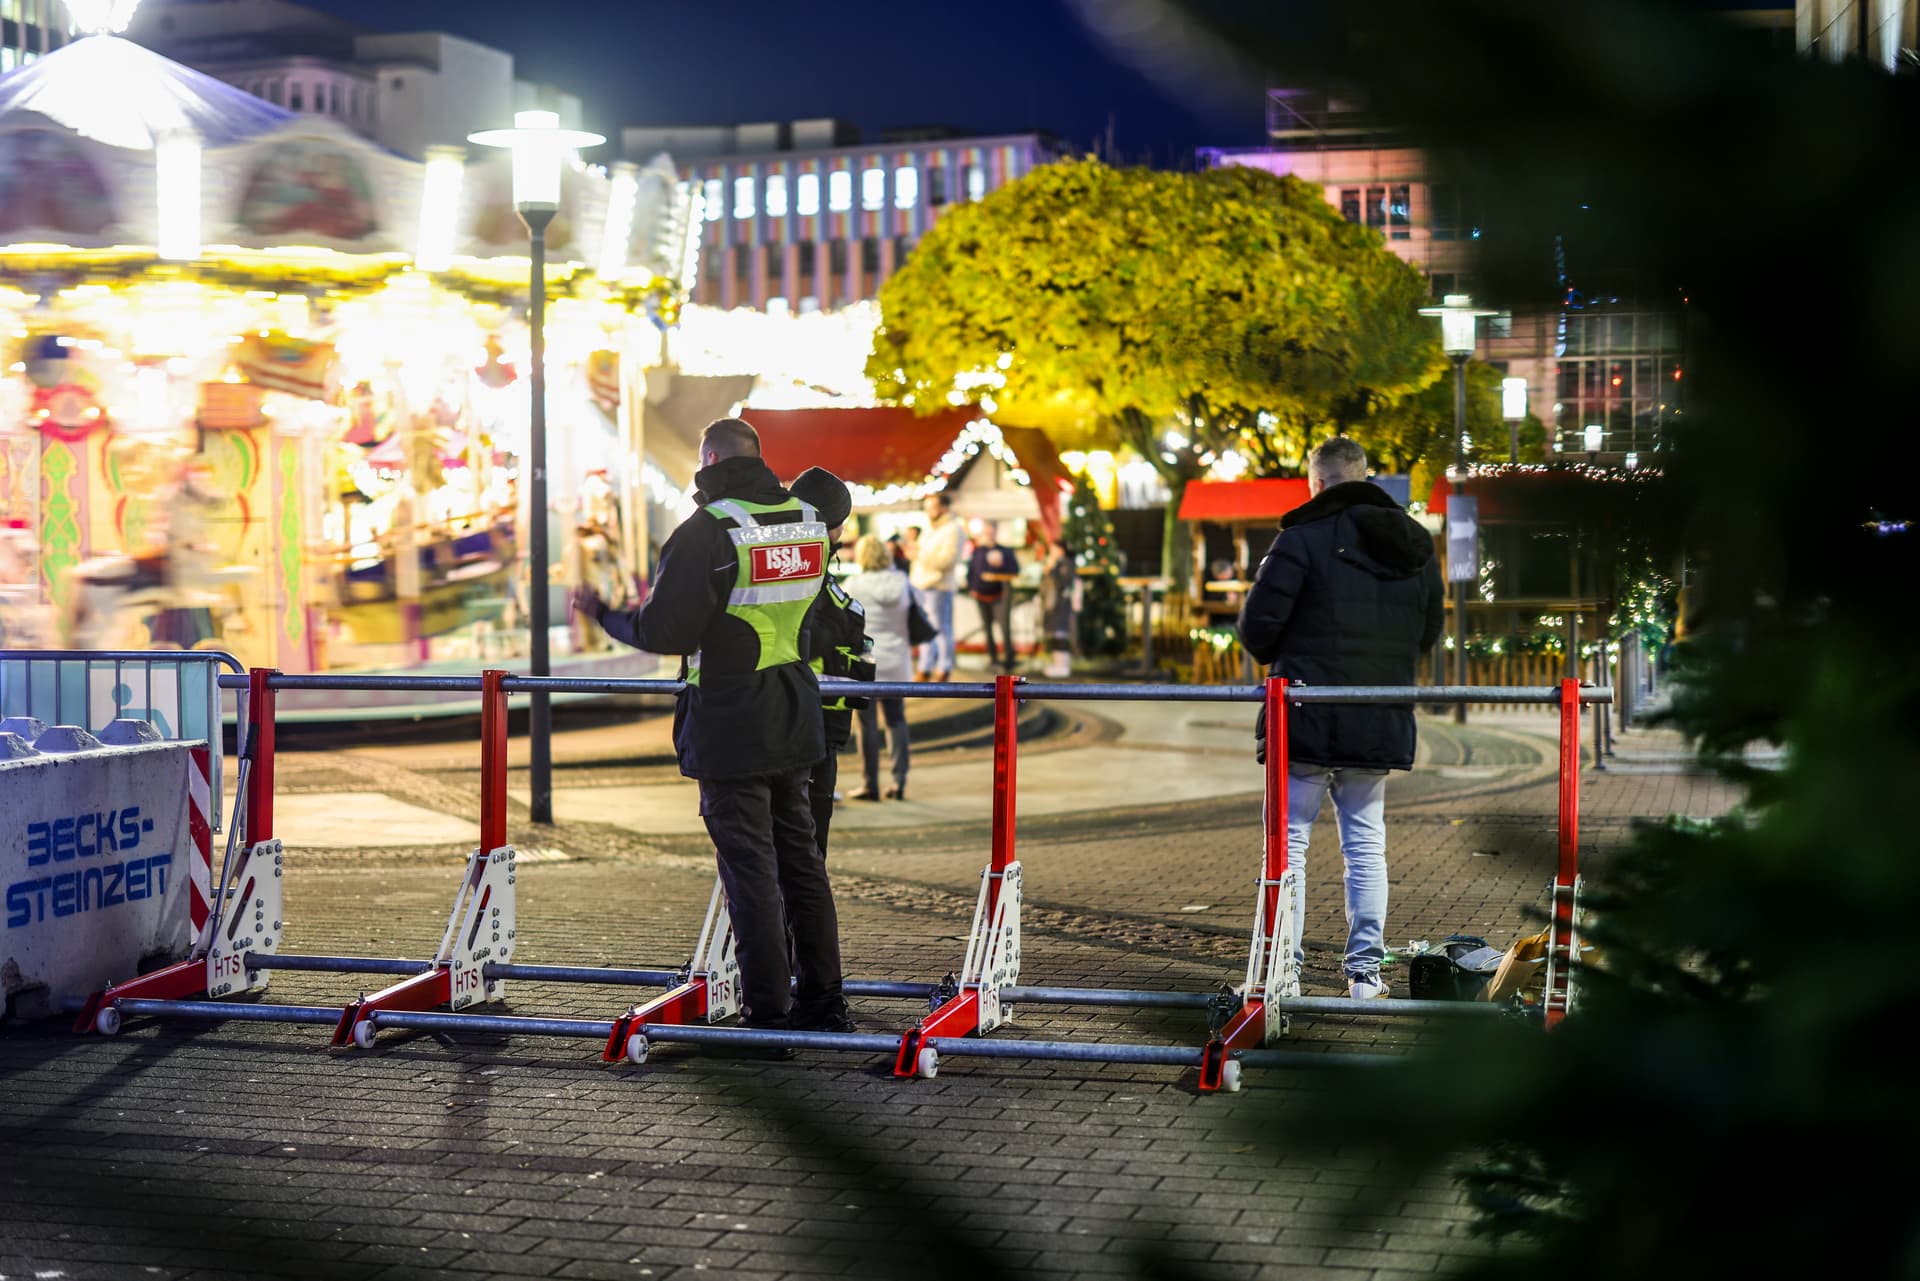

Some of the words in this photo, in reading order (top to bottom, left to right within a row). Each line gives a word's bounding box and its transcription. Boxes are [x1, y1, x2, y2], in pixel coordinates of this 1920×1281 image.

[765, 547, 802, 570] ISSA
[27, 806, 154, 867] BECKS-
[6, 853, 172, 929] STEINZEIT
[214, 953, 240, 979] HTS
[455, 967, 479, 994] HTS
[711, 979, 730, 1006] HTS
